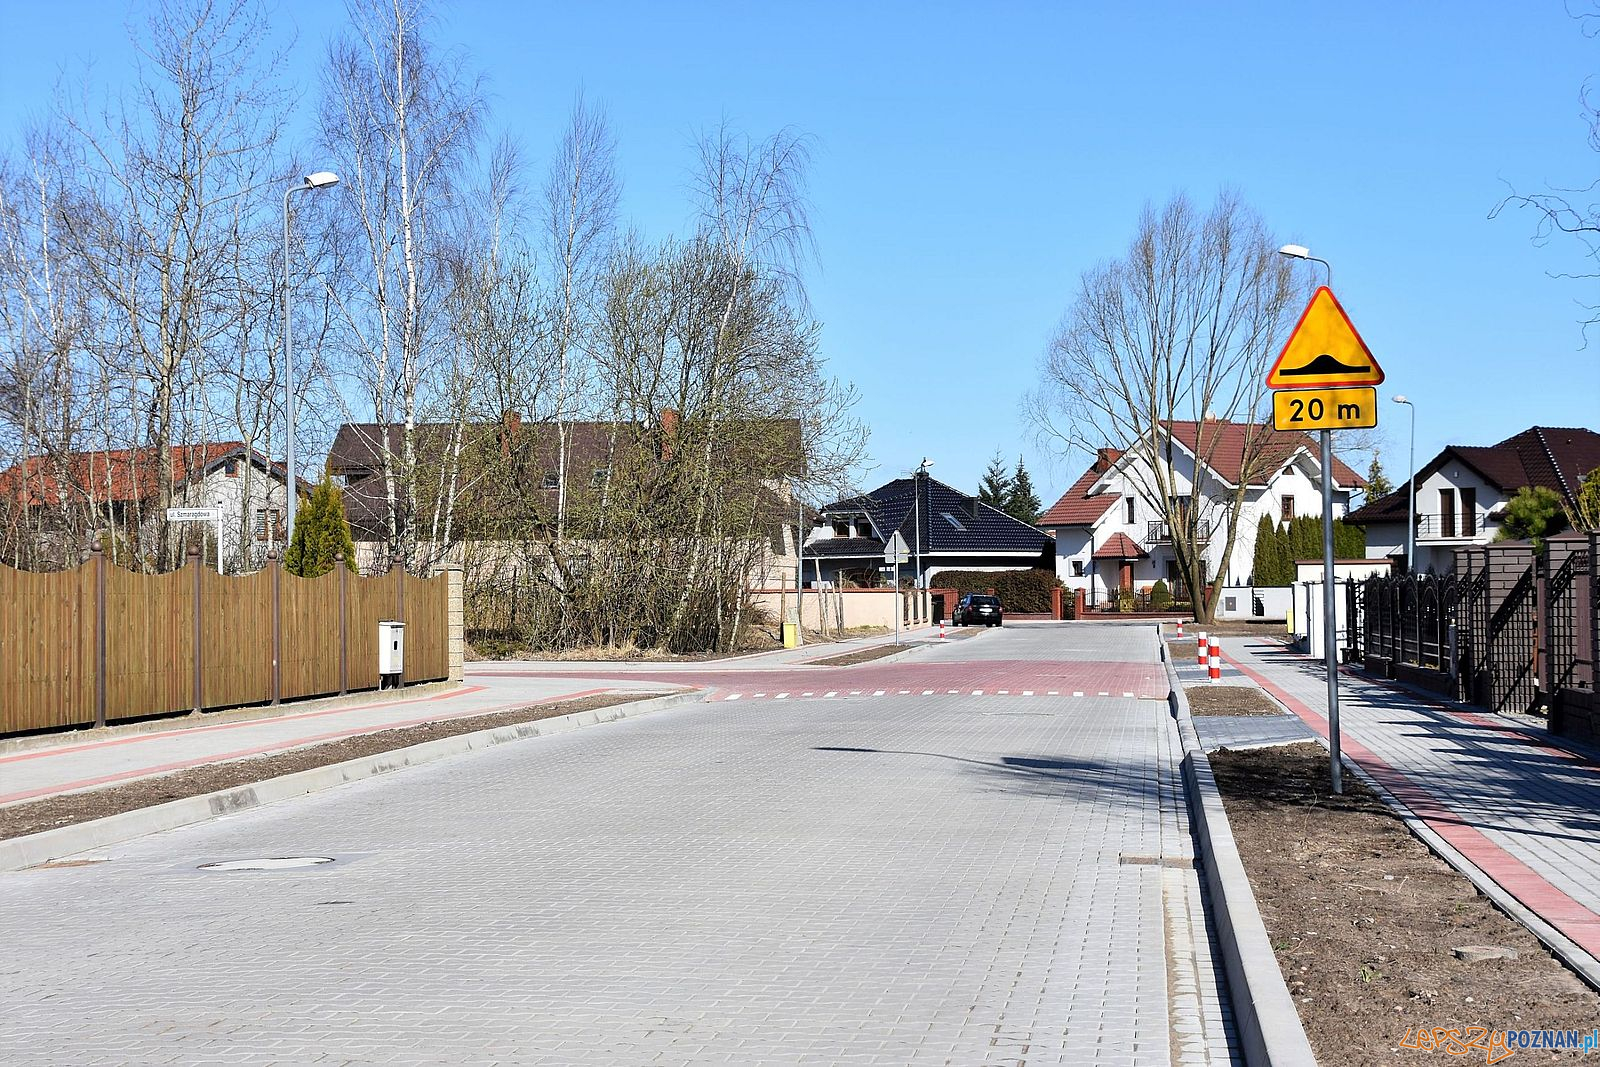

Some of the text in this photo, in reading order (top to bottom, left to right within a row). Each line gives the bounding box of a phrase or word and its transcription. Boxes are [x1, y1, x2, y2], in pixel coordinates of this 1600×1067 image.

[1290, 398, 1360, 422] 20 m
[177, 511, 210, 519] Szmaragdowa
